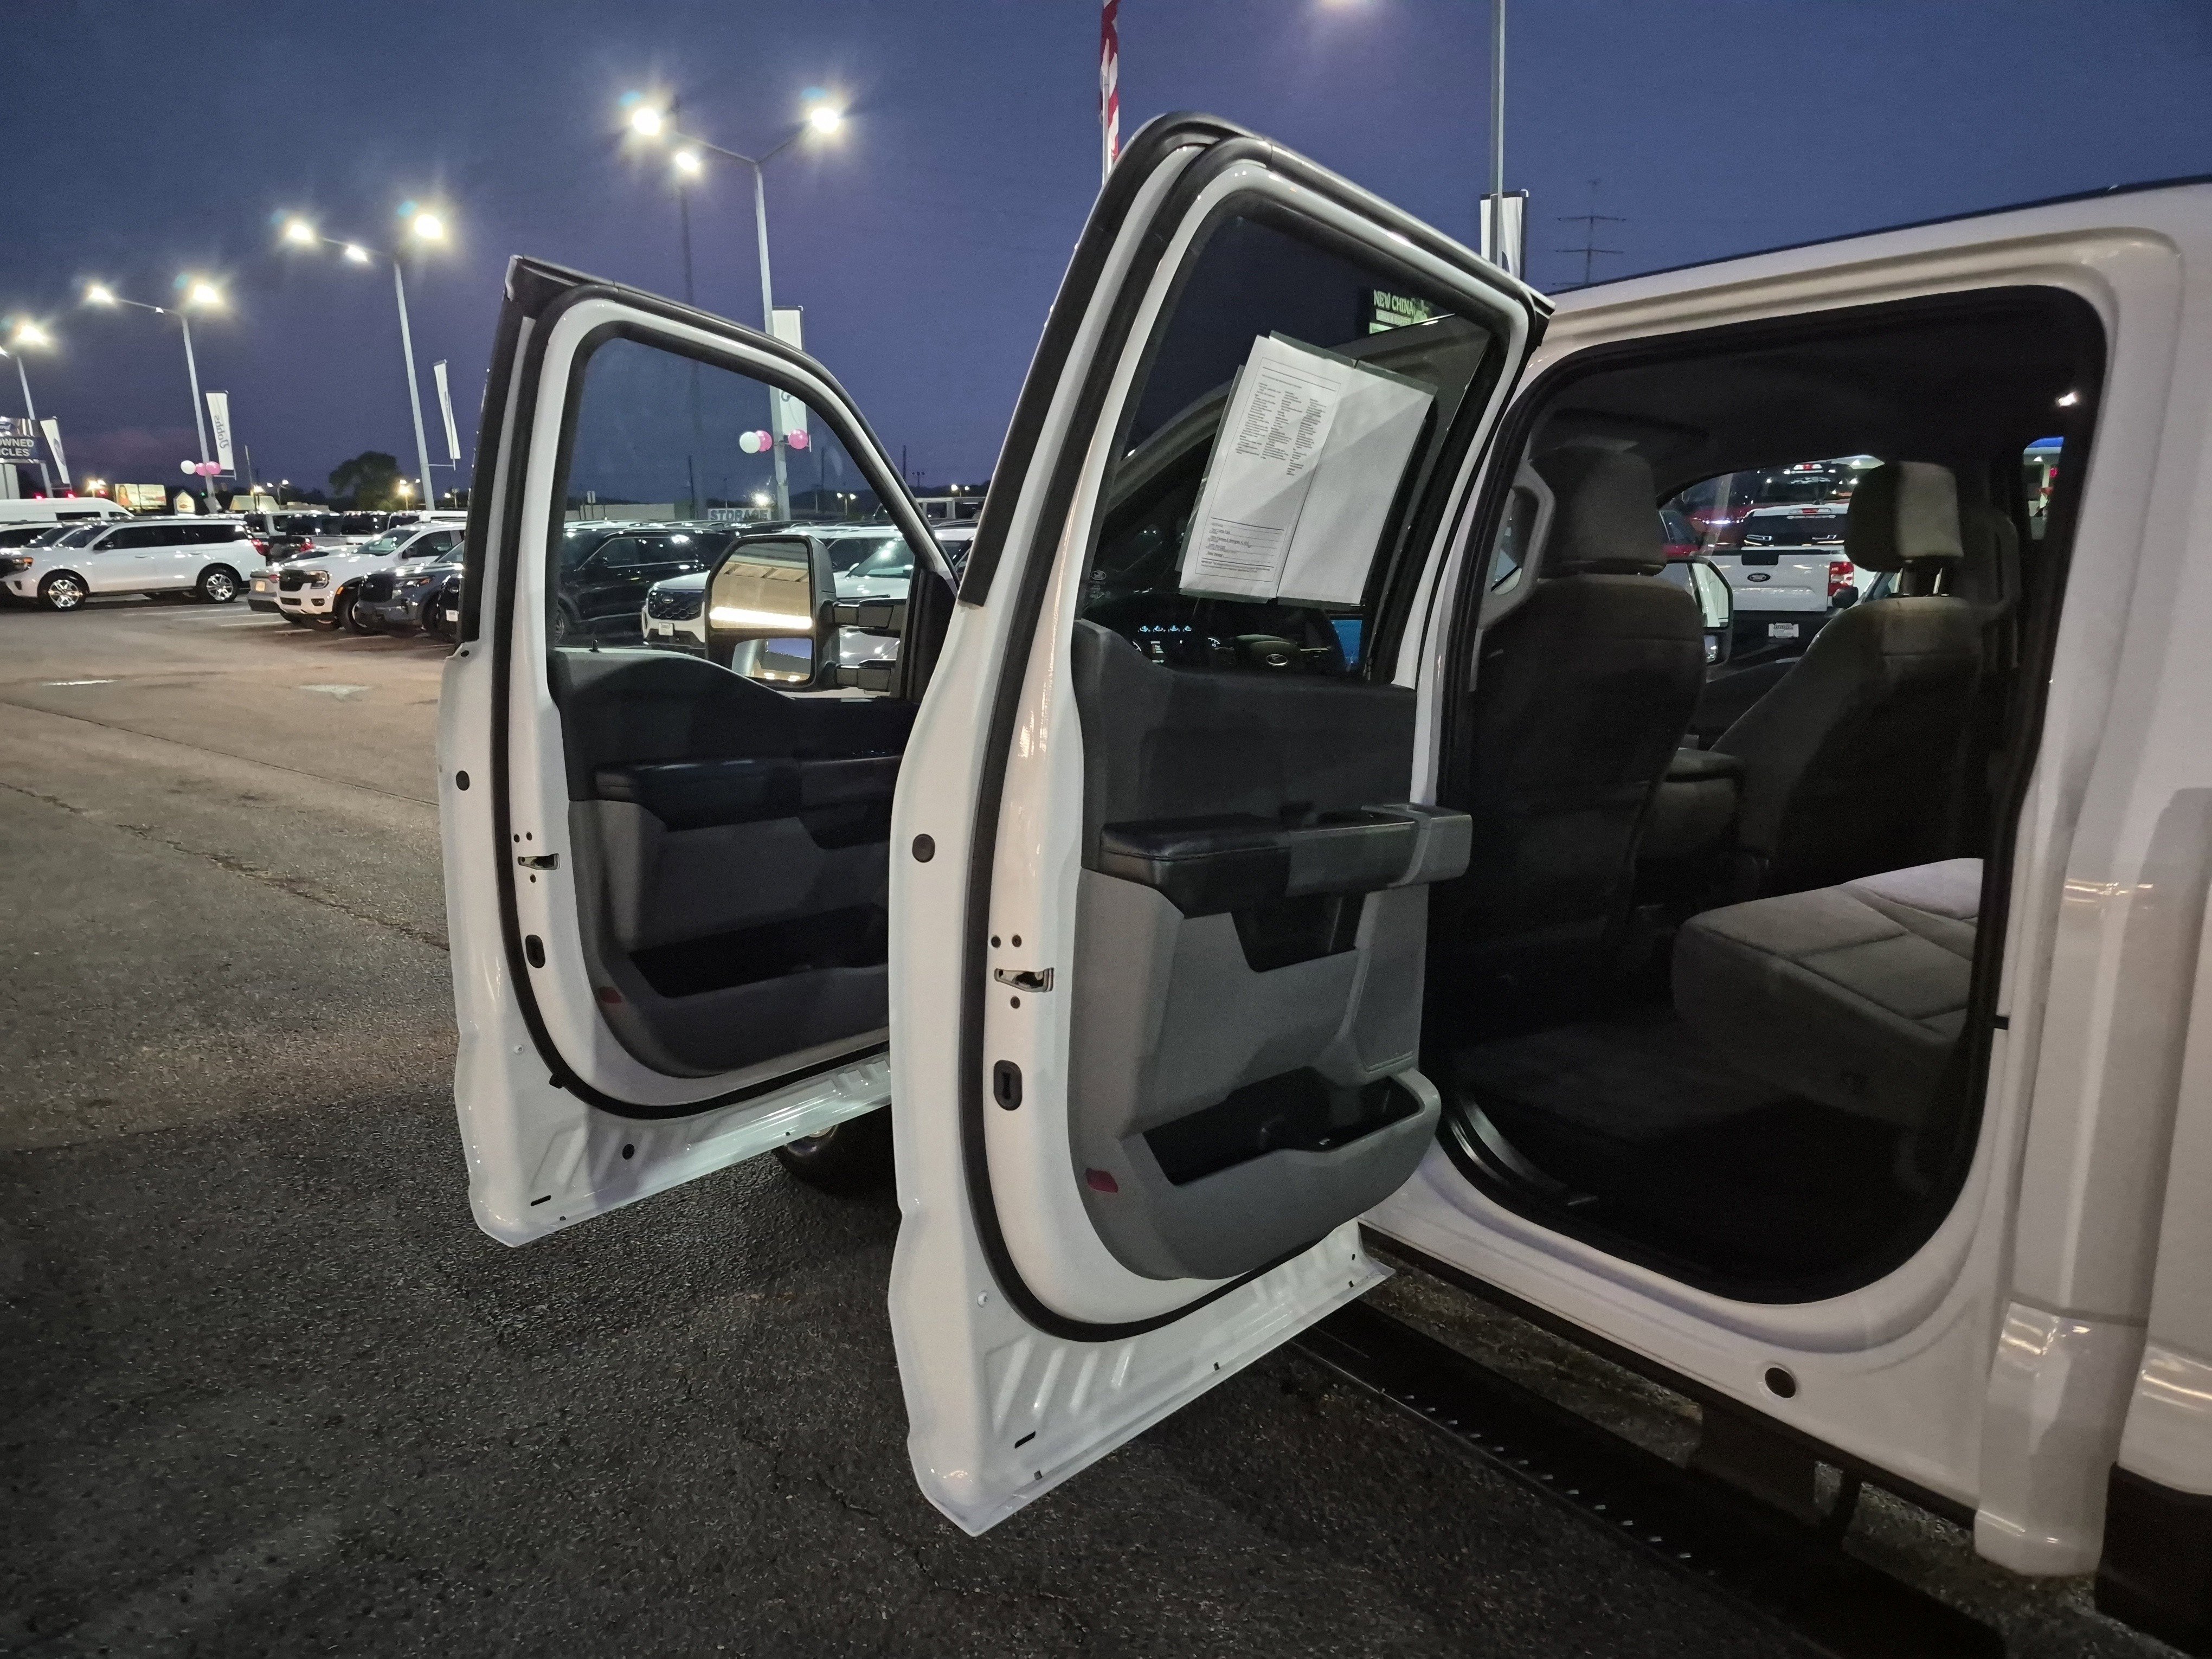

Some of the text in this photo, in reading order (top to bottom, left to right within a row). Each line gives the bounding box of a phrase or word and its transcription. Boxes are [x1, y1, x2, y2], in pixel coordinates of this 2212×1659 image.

[1373, 289, 1415, 316] NEW CHINA
[710, 510, 768, 520] STORAGE
